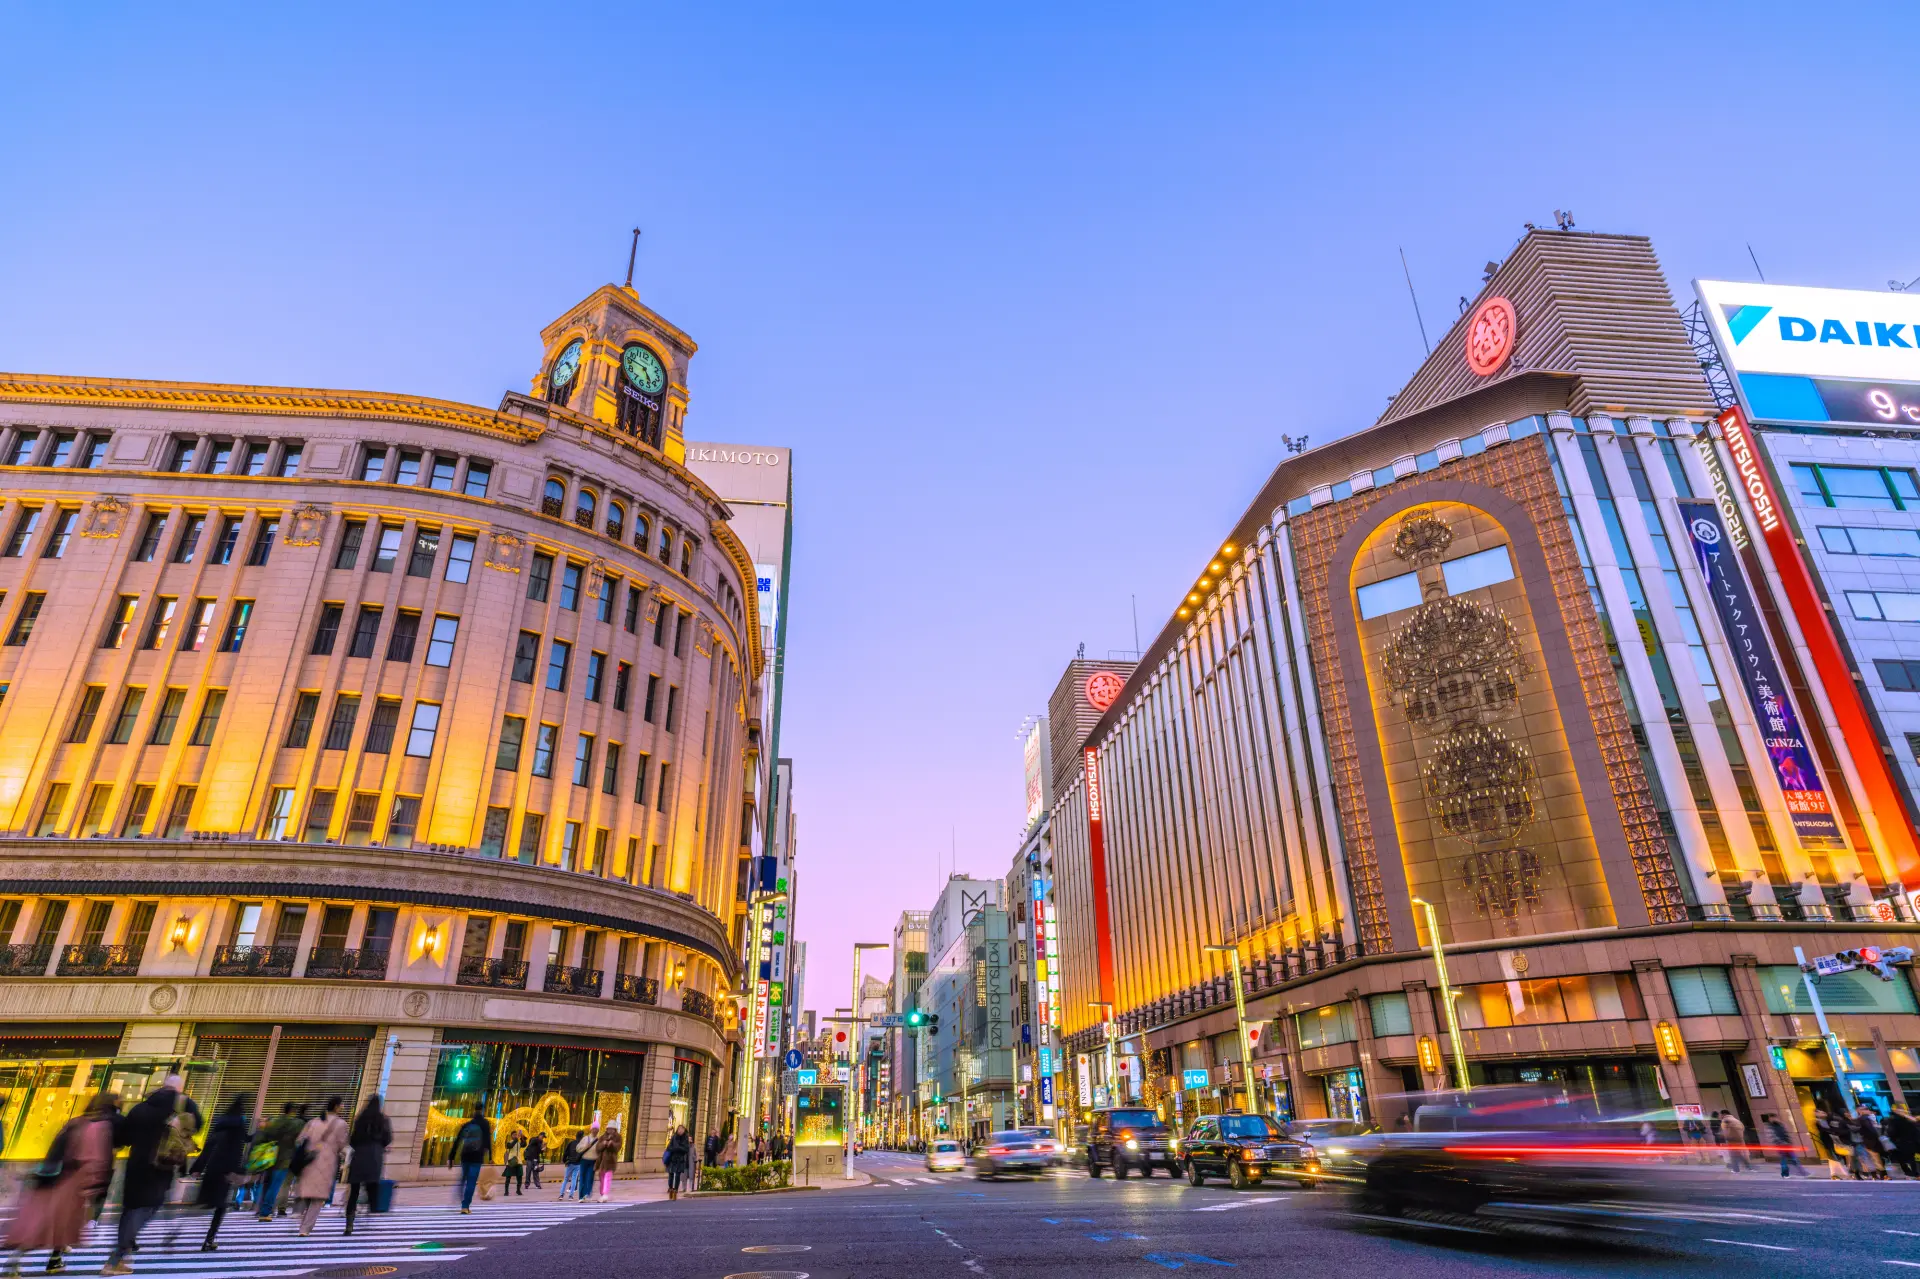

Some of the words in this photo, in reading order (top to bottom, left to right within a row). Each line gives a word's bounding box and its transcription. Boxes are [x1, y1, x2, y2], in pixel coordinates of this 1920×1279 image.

[623, 385, 659, 411] SEIKO
[1870, 390, 1896, 419] 9
[685, 448, 779, 466] IKIMOTO
[1723, 415, 1779, 531] MITSUKOSHI
[1708, 550, 1786, 732] アートアクアリウム美術館
[1765, 737, 1804, 748] GINZA
[1086, 751, 1100, 821] MITSUKOSHI
